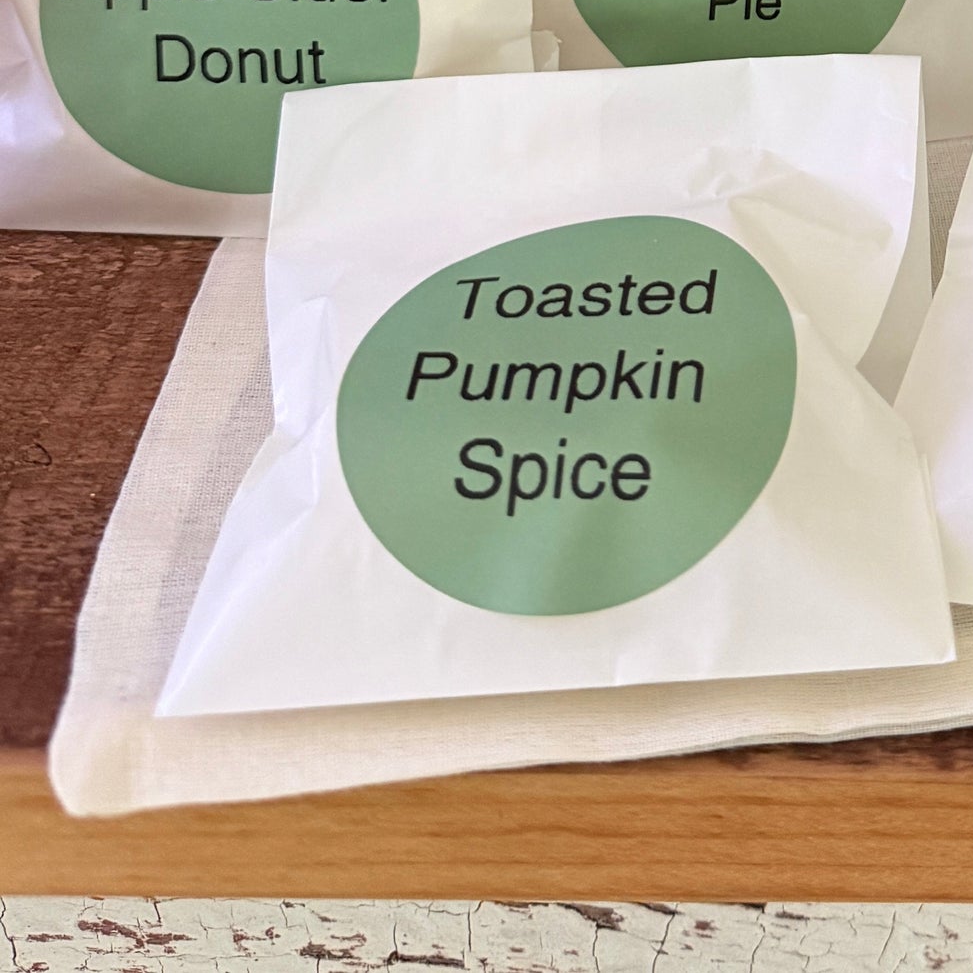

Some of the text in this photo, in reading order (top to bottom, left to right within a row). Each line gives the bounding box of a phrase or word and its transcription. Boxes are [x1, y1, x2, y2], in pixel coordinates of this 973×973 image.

[154, 33, 328, 86] Donut
[455, 268, 719, 321] Toasted
[405, 347, 705, 415] Pumpkin
[453, 437, 652, 518] Spice
